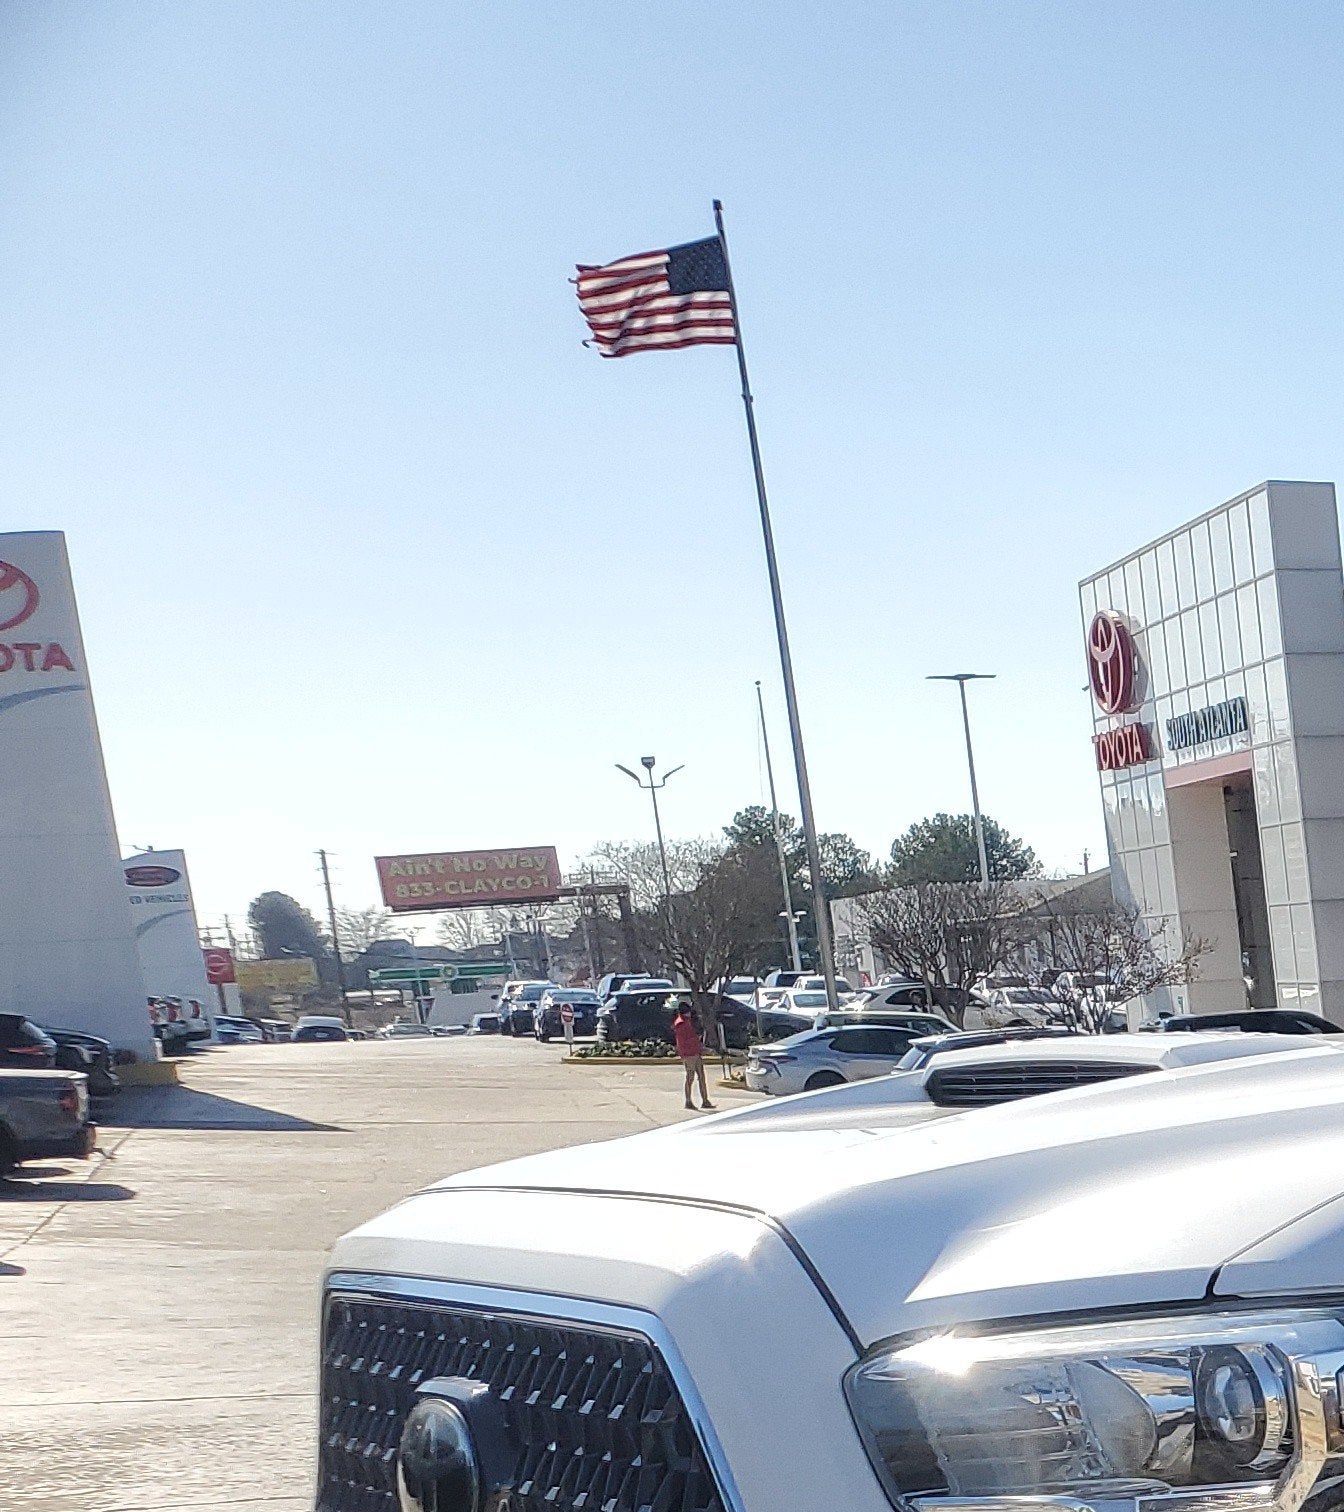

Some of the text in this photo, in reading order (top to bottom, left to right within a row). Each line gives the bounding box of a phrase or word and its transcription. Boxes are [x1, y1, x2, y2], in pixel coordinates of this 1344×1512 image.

[1092, 722, 1145, 771] TOYOTA
[1166, 696, 1248, 750] SOUTH ATLANTA
[452, 856, 487, 873] No
[494, 854, 548, 873] Way
